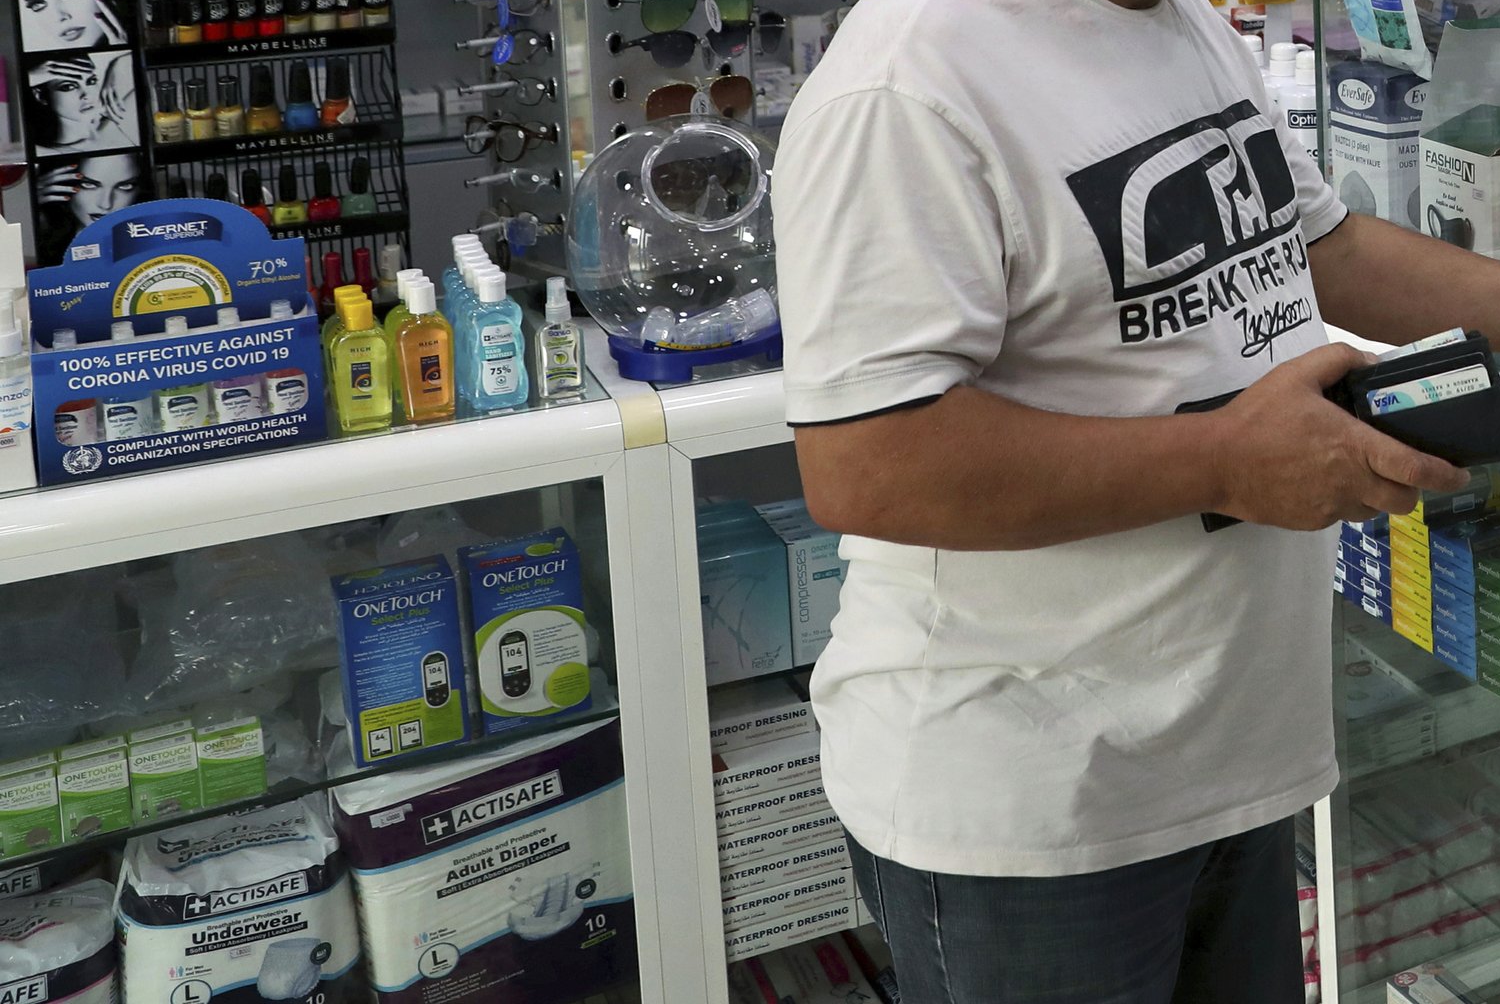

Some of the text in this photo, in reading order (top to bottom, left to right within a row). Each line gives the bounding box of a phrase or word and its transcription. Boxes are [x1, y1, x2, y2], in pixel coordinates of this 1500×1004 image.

[228, 37, 327, 53] MAYBELLINE
[1341, 81, 1374, 107] EverSafe
[1399, 160, 1417, 168] DUST
[133, 220, 207, 238] EVERNET
[164, 230, 204, 240] SUPERIOR
[248, 258, 287, 278] 70%
[35, 281, 110, 297] Hand Sanitizer
[1119, 265, 1247, 344] BREAK
[1240, 247, 1285, 294] THE
[60, 328, 294, 373] 100% EFFECTIVE AGAINST
[68, 347, 289, 390] CORONA VIRUS COVID 19
[490, 365, 511, 376] 75%
[1374, 394, 1400, 407] VISA
[107, 413, 307, 454] COMPLIANT WITH WORLD HEALTH
[108, 426, 299, 466] ORGANIZATION SPECIFICATIONS
[482, 559, 566, 588] ONETOUCH
[499, 576, 554, 595] Select Plus
[353, 589, 442, 618] ONETOUCH
[371, 607, 430, 626] Select Plus
[506, 648, 522, 658] 104
[403, 725, 417, 734] 204
[456, 778, 555, 828] ACTISAFE
[446, 832, 560, 883] Adult Diaper
[453, 827, 547, 866] Breathable and Protective
[721, 859, 790, 883] WATERPROOF
[793, 845, 845, 865] DRESSING
[212, 877, 300, 910] ACTISAFE
[191, 910, 302, 945] Underwear
[585, 914, 607, 933] 10
[725, 906, 849, 947] WATERPROOF DRESSING
[432, 950, 448, 967] L
